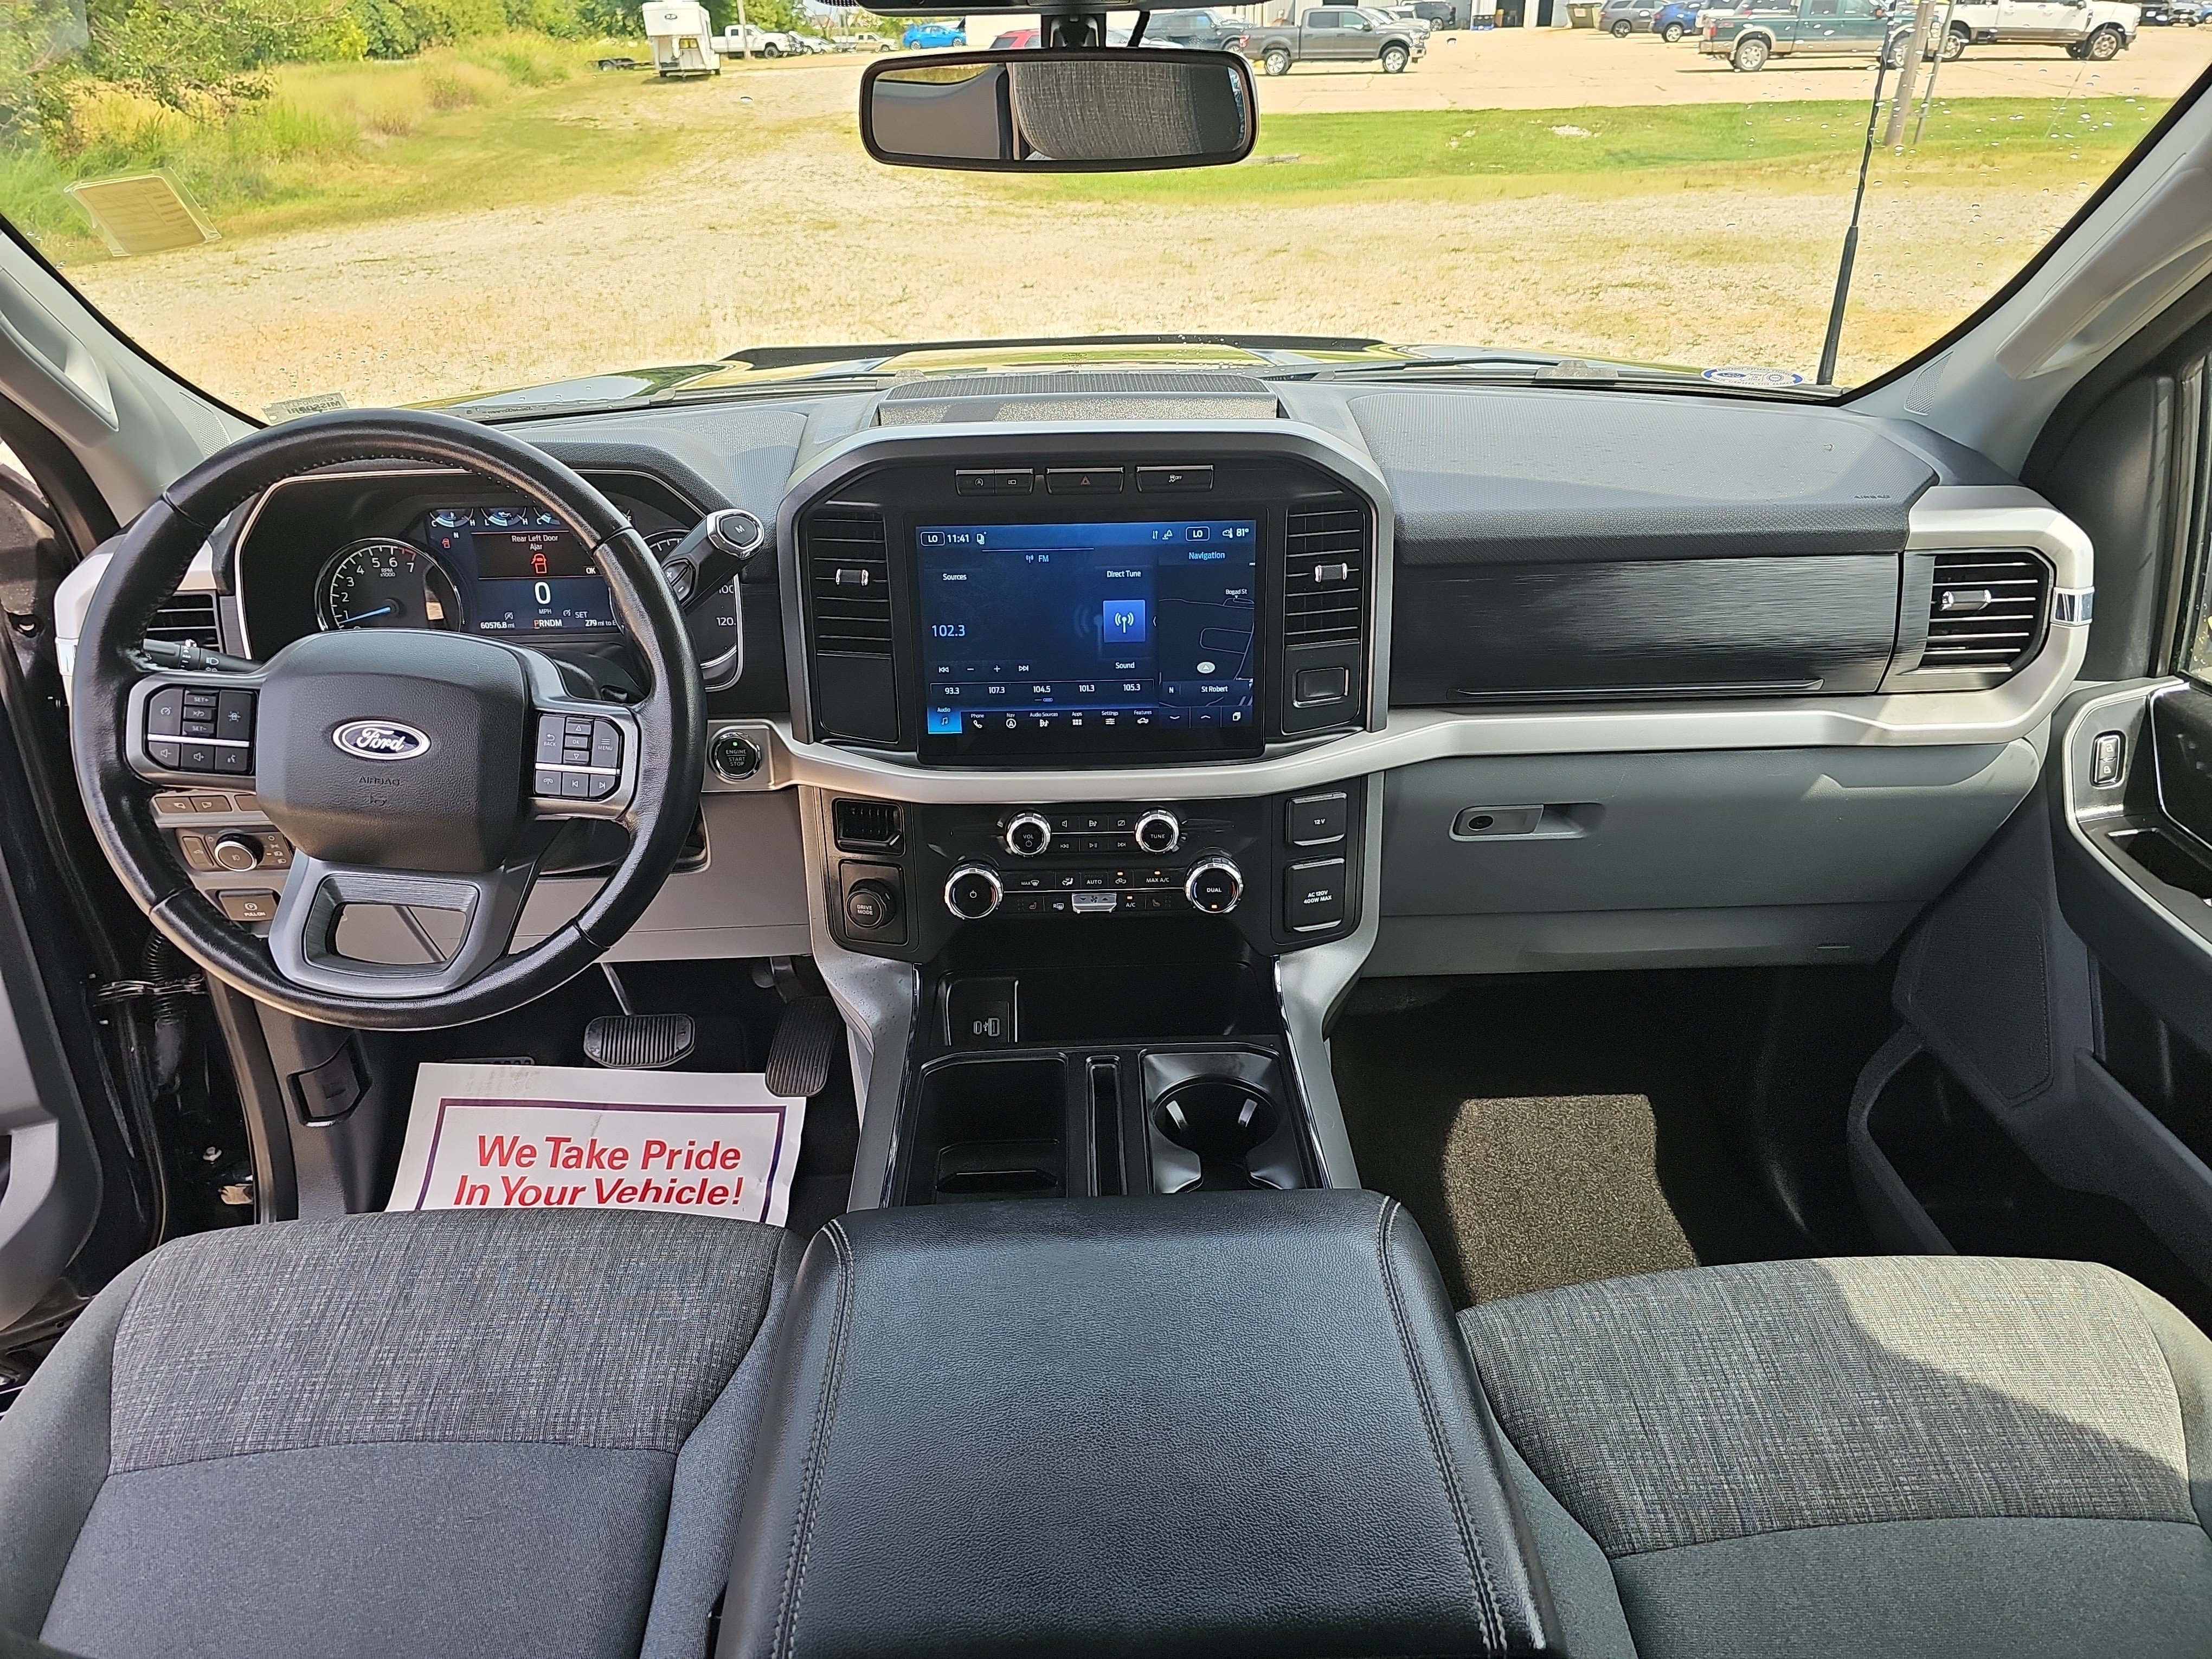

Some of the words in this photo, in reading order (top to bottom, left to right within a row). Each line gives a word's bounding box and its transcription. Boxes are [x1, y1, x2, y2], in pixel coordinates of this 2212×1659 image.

[928, 535, 938, 543] LO
[947, 534, 969, 543] 11:41
[1193, 530, 1203, 538] LO
[1188, 551, 1225, 560] Navigation
[371, 557, 381, 568] 5
[389, 557, 398, 568] 6
[406, 562, 414, 573] 7
[356, 565, 365, 575] 4
[346, 576, 355, 587] 3
[341, 592, 350, 602] 2
[535, 582, 551, 605] 0
[343, 610, 349, 620] 1
[716, 617, 734, 626] 120
[931, 625, 966, 637] 102.3
[356, 728, 406, 753] Ford
[478, 1134, 537, 1168] We
[545, 1135, 629, 1171] Take
[640, 1139, 741, 1171] Pride
[454, 1174, 490, 1206] In
[501, 1175, 586, 1207] Your
[595, 1176, 743, 1206] Vehicle!
